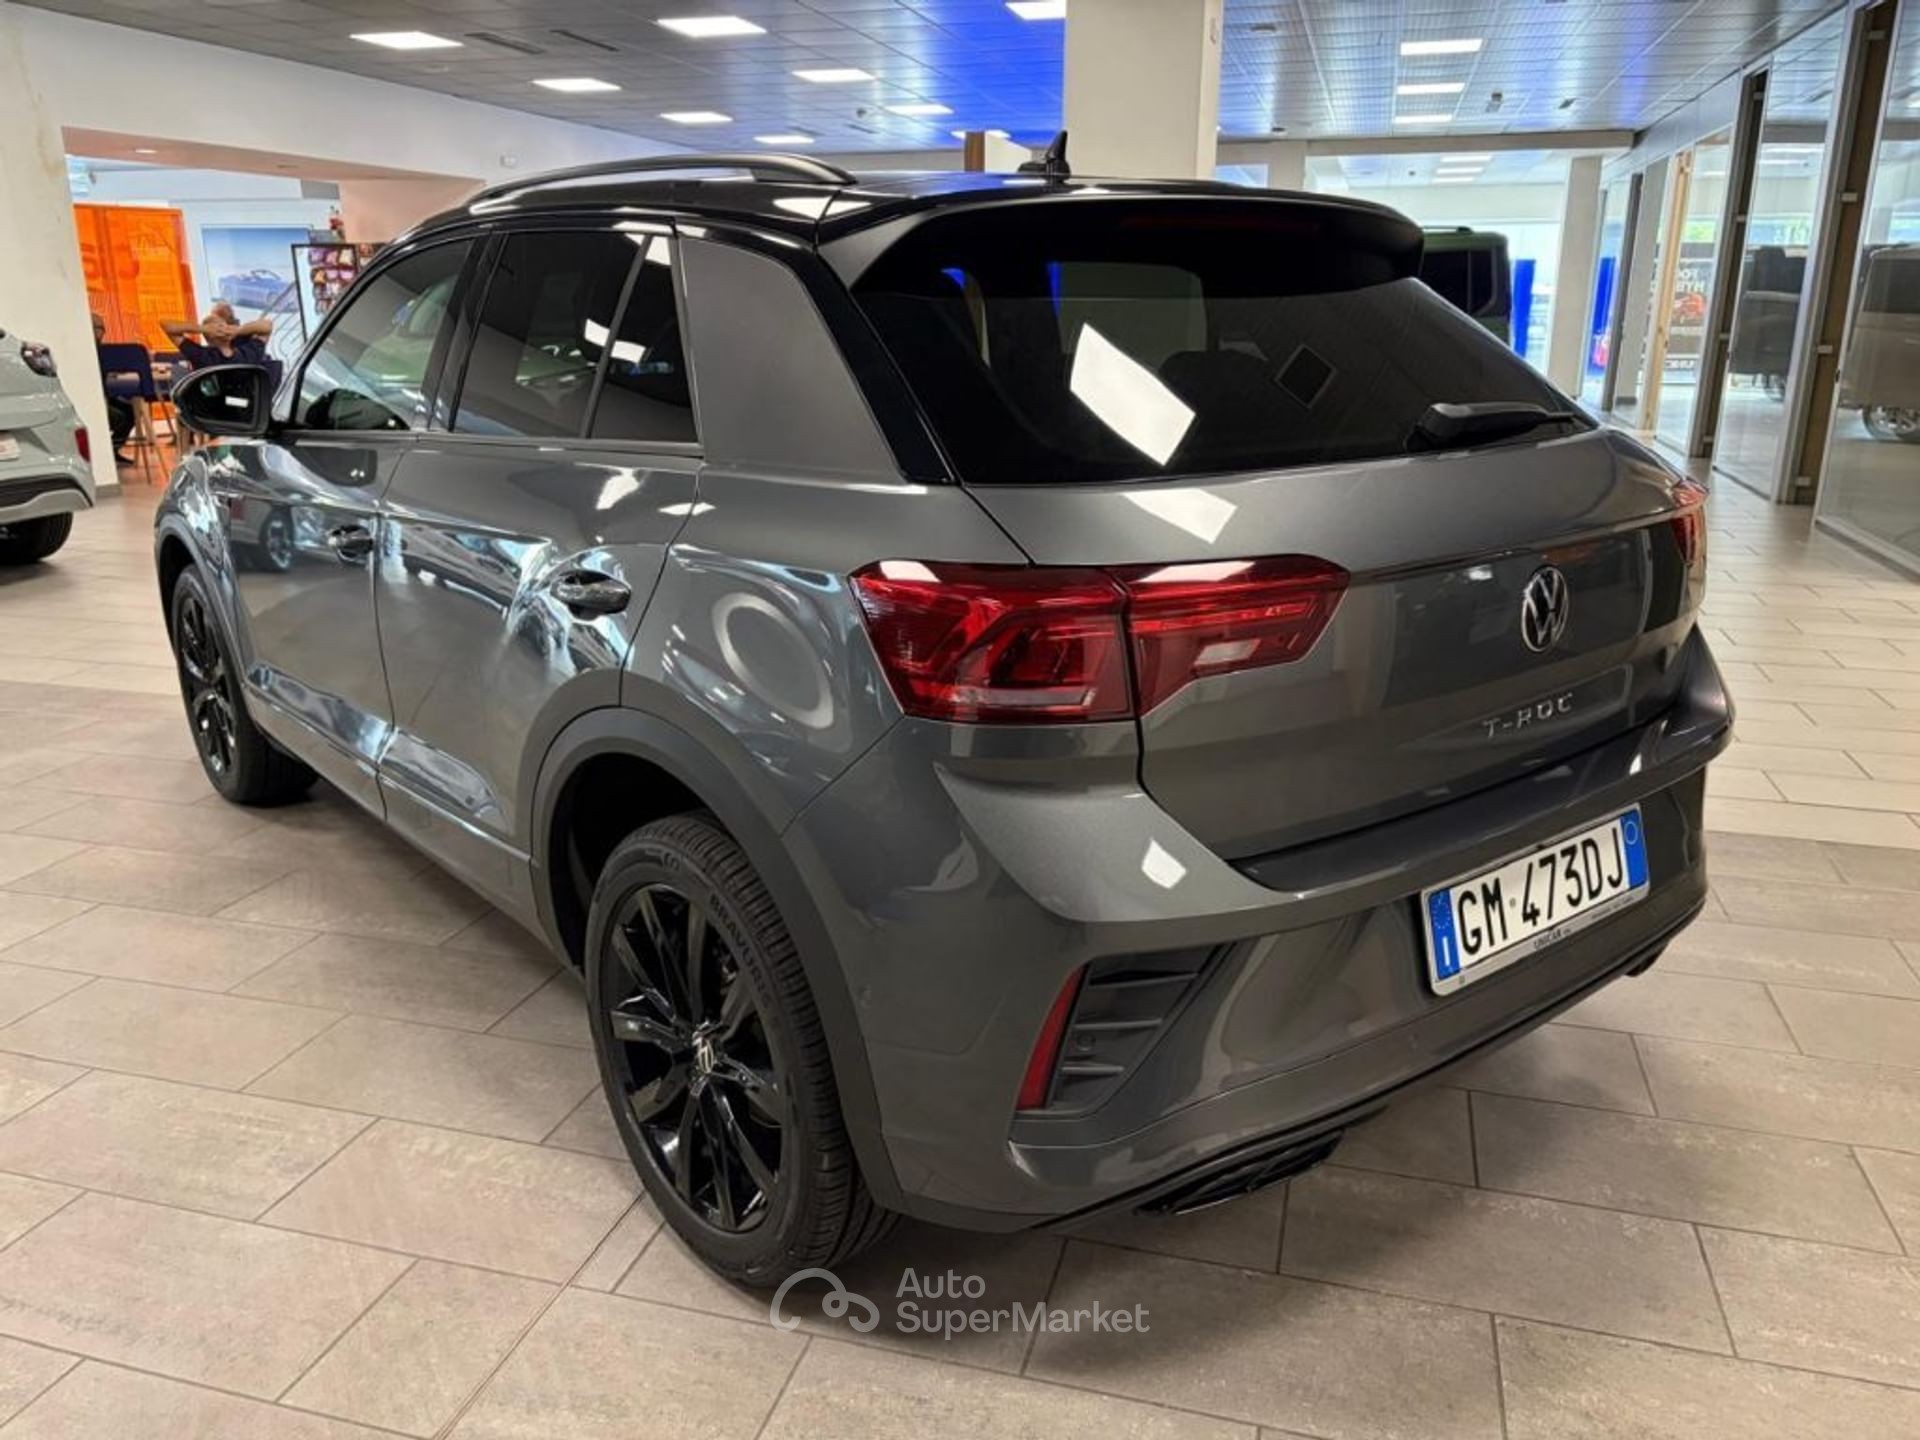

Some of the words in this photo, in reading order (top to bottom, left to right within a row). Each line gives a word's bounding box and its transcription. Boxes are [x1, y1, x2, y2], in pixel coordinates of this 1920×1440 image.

[1482, 692, 1573, 738] T-ROC
[1457, 877, 1508, 955] GM
[1522, 827, 1624, 926] 473DJ
